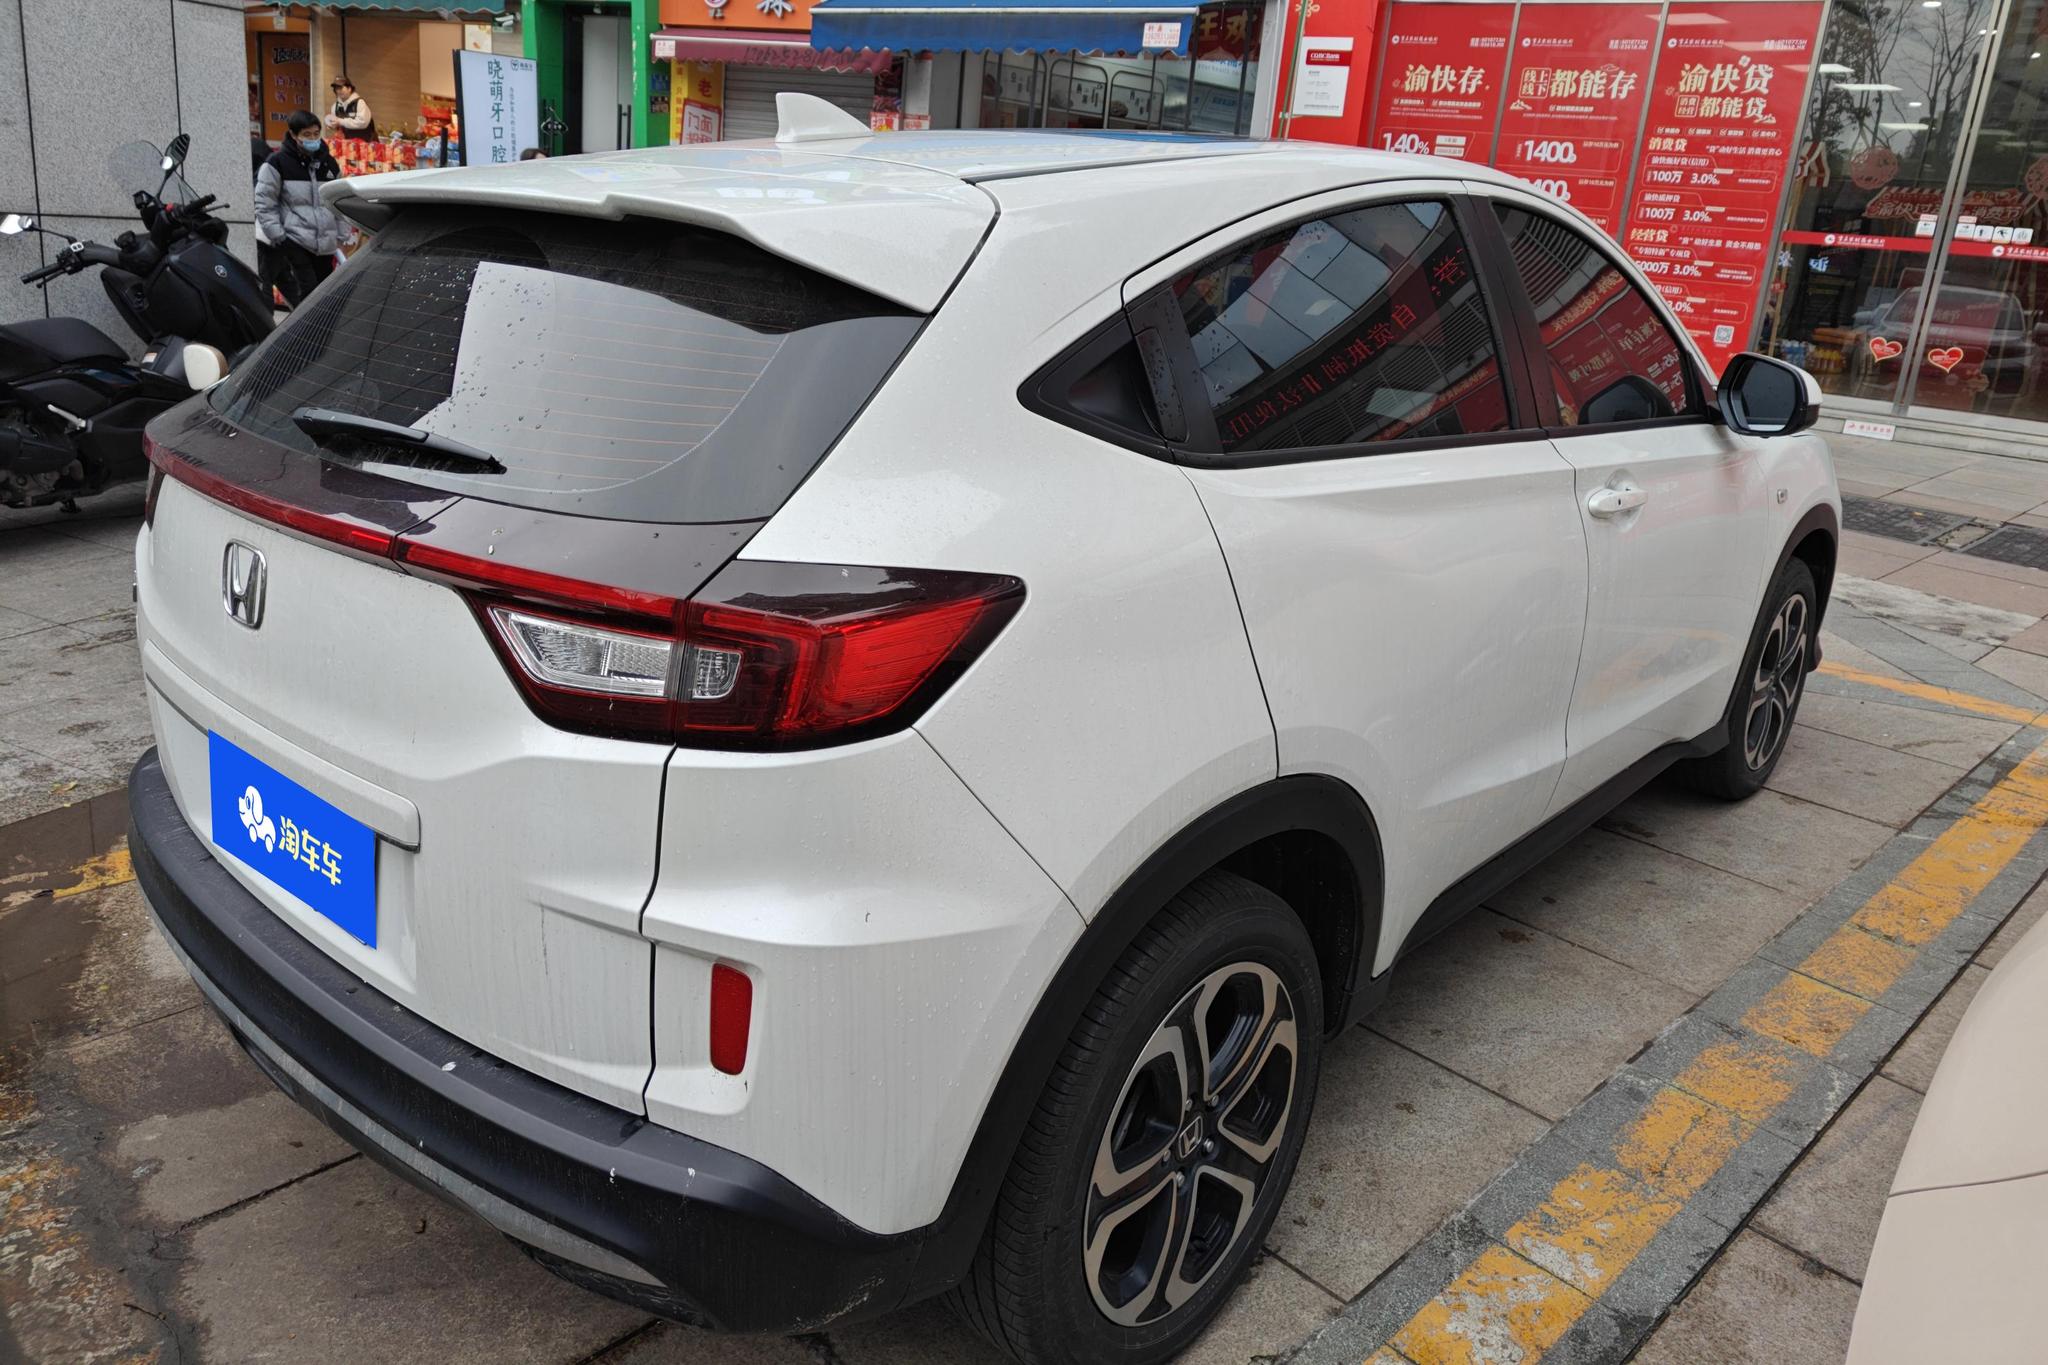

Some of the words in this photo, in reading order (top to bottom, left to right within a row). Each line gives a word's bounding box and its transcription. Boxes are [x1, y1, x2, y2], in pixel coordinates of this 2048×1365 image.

[1404, 63, 1486, 94] 渝快存
[1521, 82, 1547, 96] 线下
[1523, 70, 1549, 82] 线上
[1550, 68, 1638, 99] 都能存
[1678, 63, 1774, 94] 渝快贷
[488, 59, 508, 163] 晓萌牙口腔
[1699, 95, 1767, 121] 都能贷
[1648, 136, 1688, 152] 消费贷
[1630, 228, 1669, 243] 经营贷
